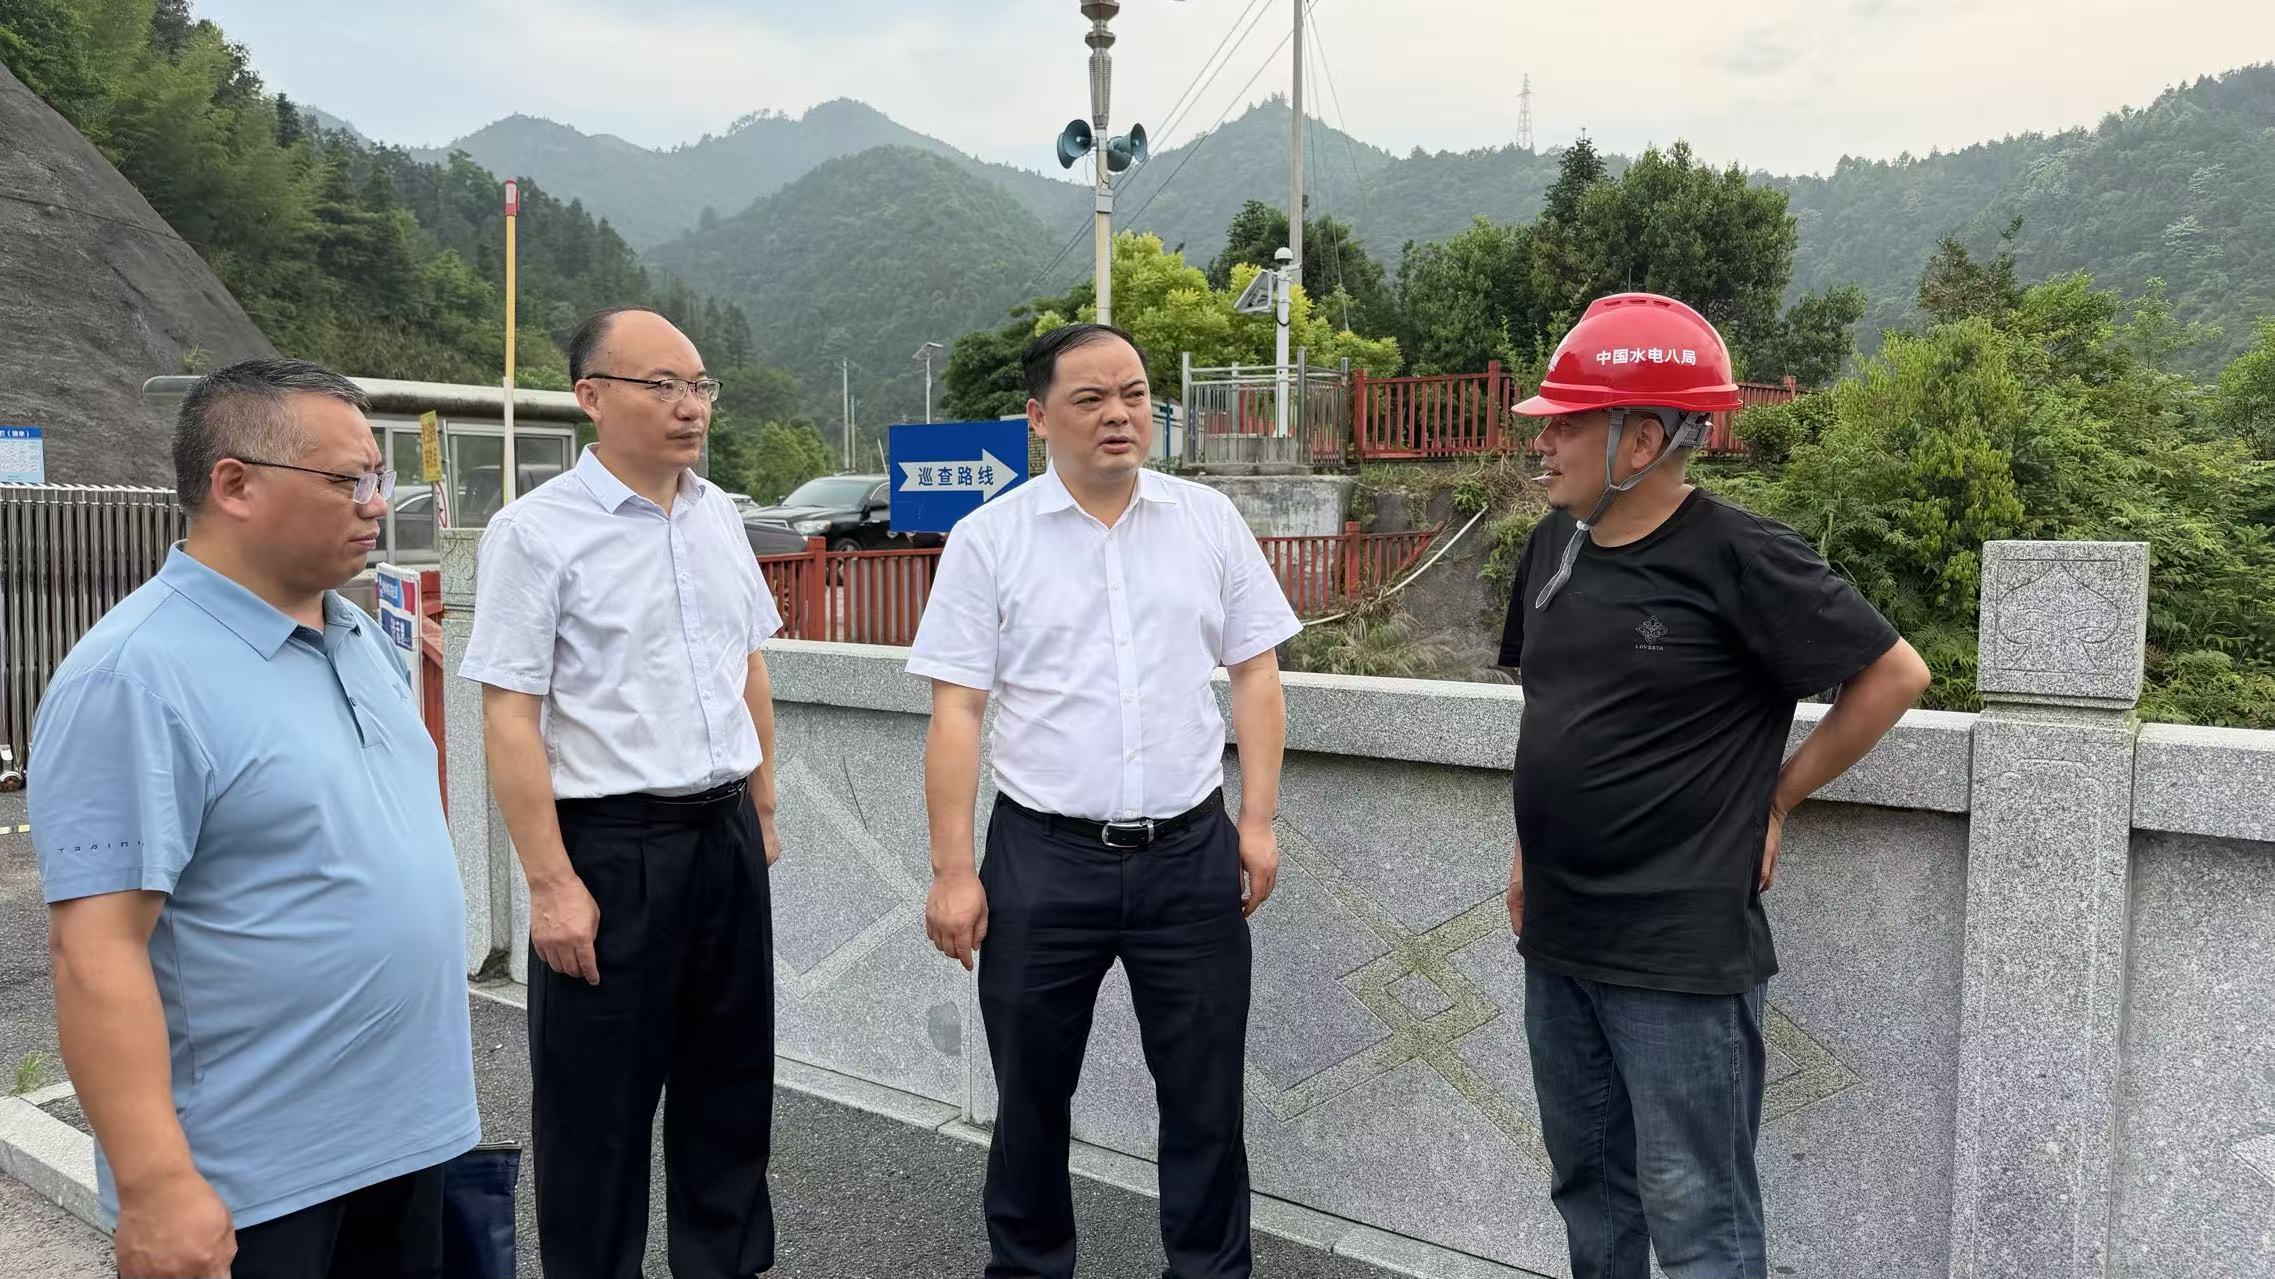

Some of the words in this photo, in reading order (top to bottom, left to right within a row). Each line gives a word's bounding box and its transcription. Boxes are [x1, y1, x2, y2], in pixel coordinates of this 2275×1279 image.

[1596, 348, 1697, 366] 中国水电八局
[918, 466, 994, 486] 巡查路线
